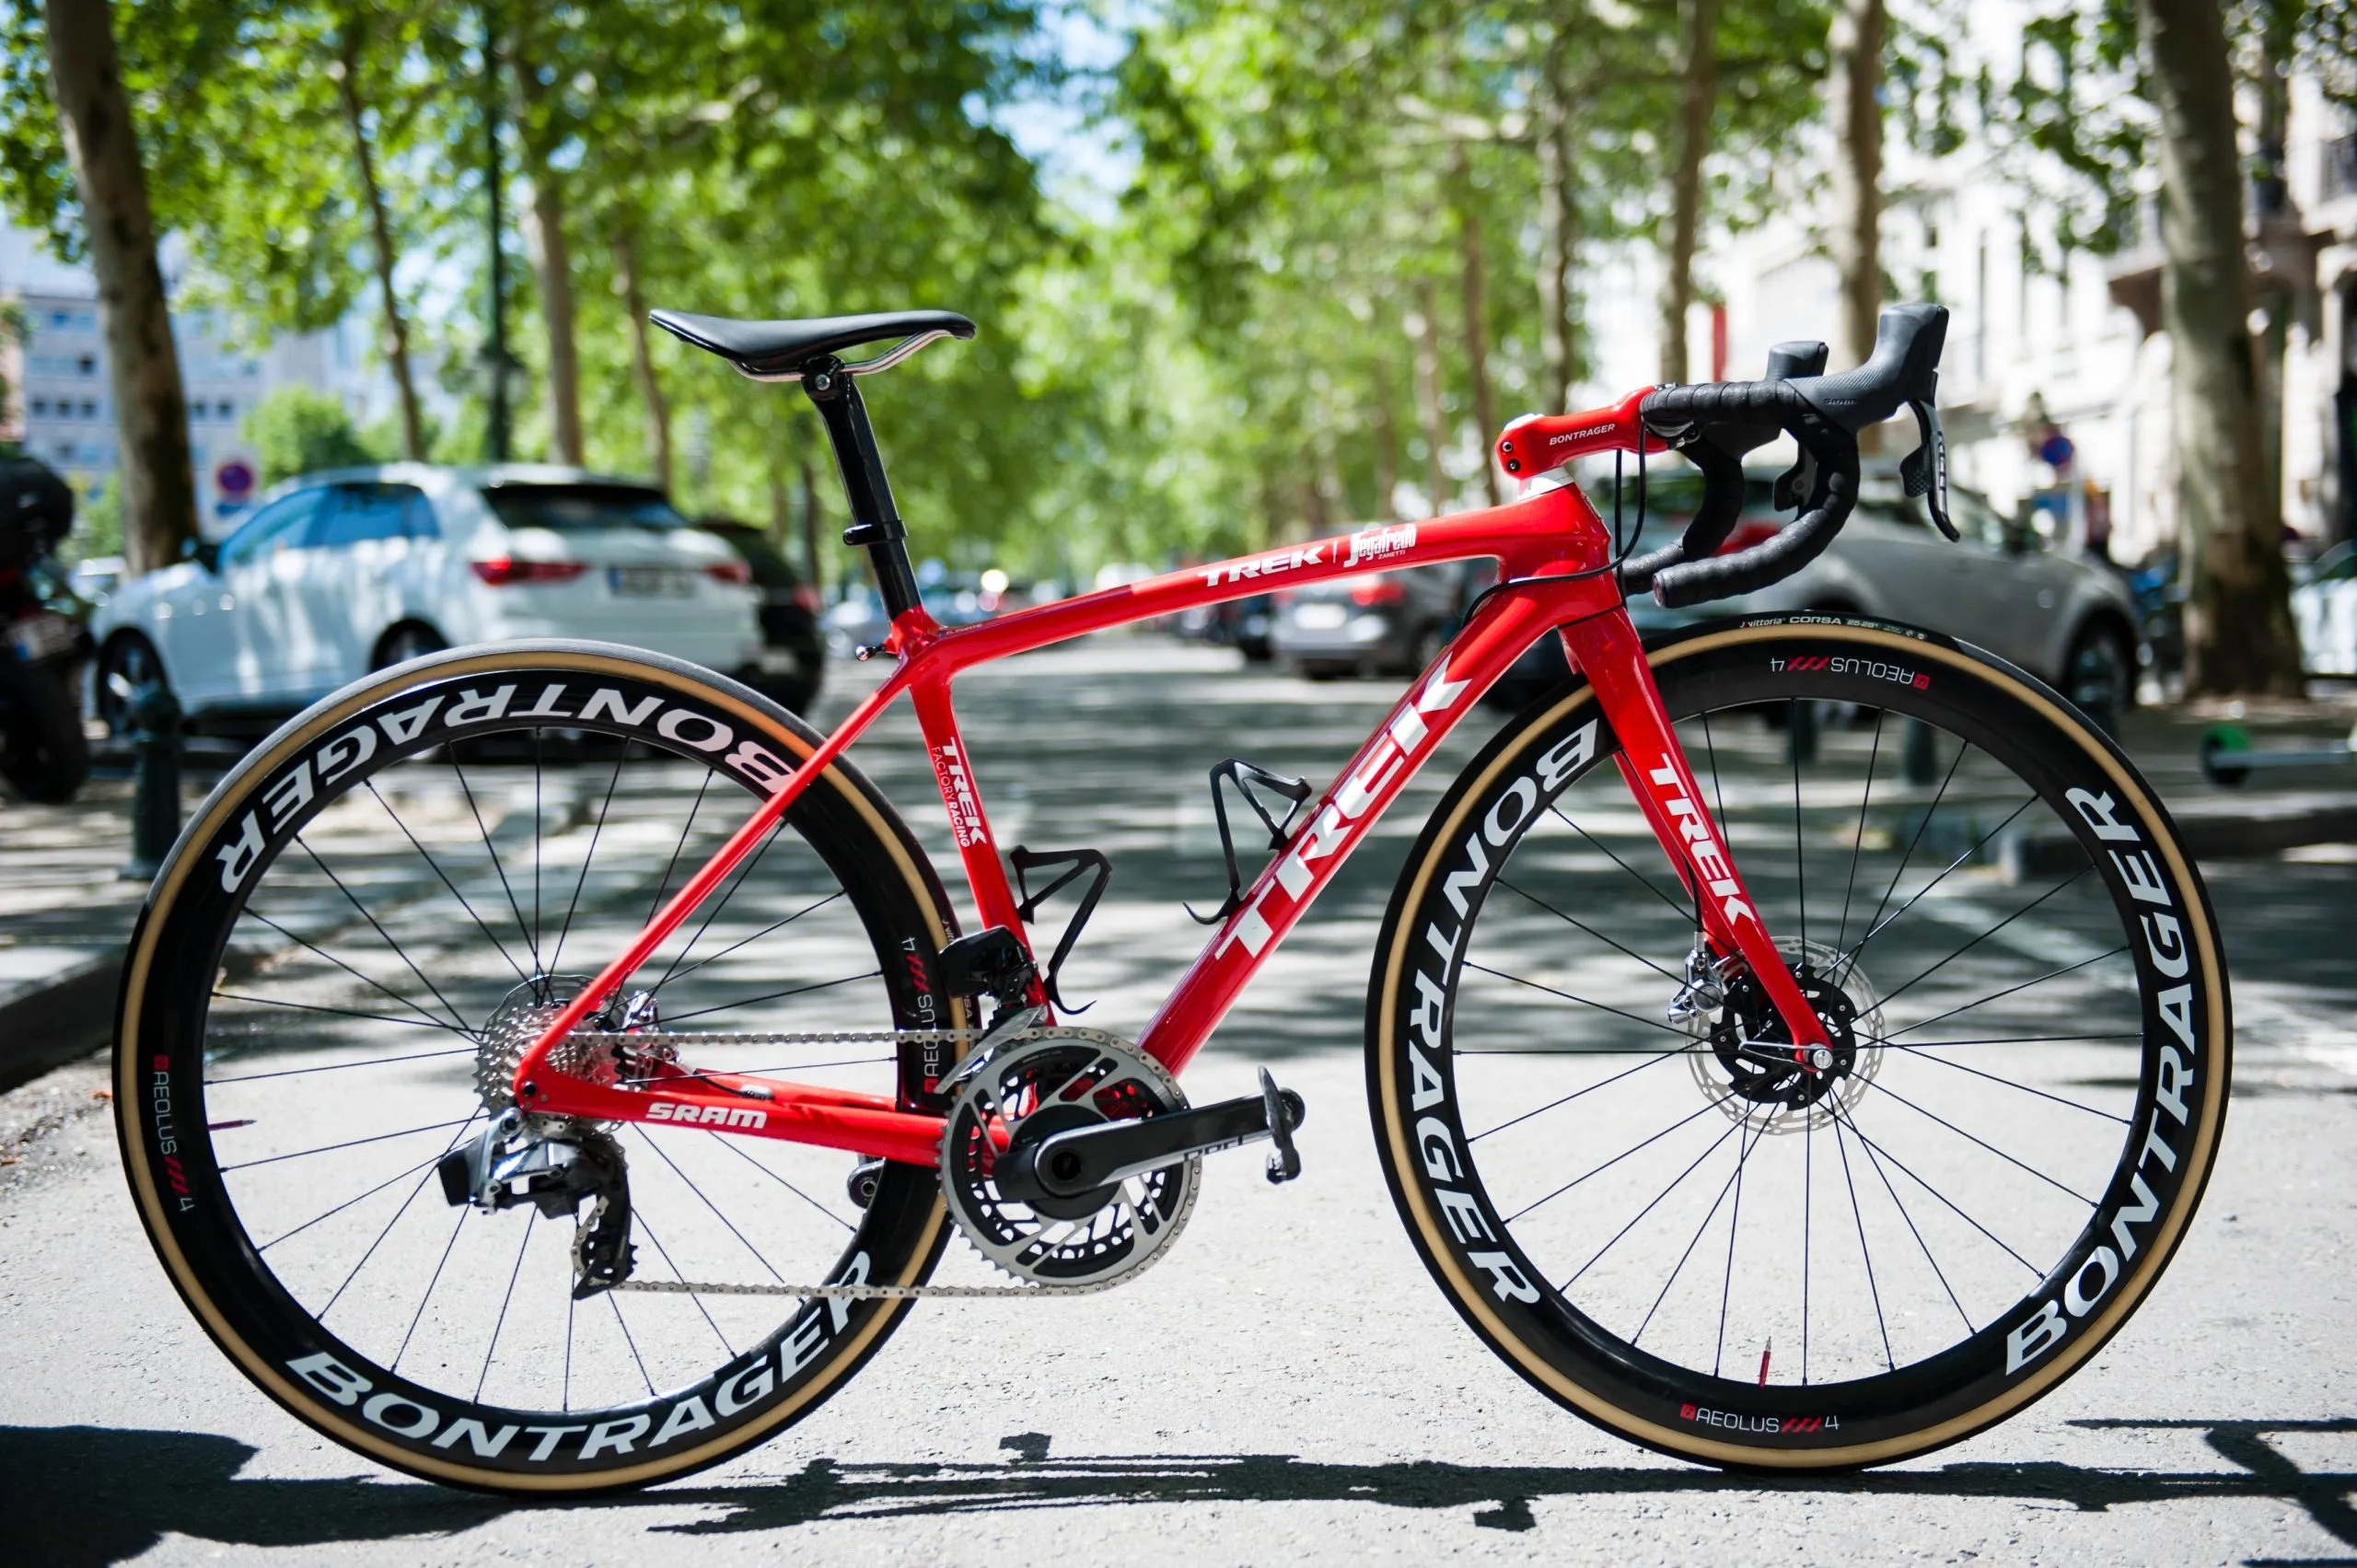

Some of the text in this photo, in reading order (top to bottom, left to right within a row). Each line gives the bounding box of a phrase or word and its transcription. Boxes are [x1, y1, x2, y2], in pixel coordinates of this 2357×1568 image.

[1549, 423, 1616, 446] BONTRAGER
[1198, 545, 1326, 587] TREK
[1343, 523, 1417, 567] Segafredo
[1377, 550, 1406, 560] ZANETTI
[1747, 618, 1782, 627] vittoria
[1789, 616, 1841, 625] CORSA
[1771, 657, 1914, 684] AEOLUS 4
[216, 684, 795, 893] BONTRAGER
[931, 747, 970, 847] FACTORY RACING
[942, 737, 987, 845] TREK
[1214, 651, 1472, 960] TREK
[1649, 753, 1757, 926] TREK
[901, 936, 917, 951] 4
[1409, 718, 1598, 1304] BONTRAGER
[645, 1102, 767, 1129] SRAM
[2006, 786, 2195, 1376] BONTRAGER
[153, 1071, 195, 1212] AEOLUS 4
[285, 1250, 871, 1462] BONTRAGER
[1696, 1408, 1840, 1433] AEOLUS 4
